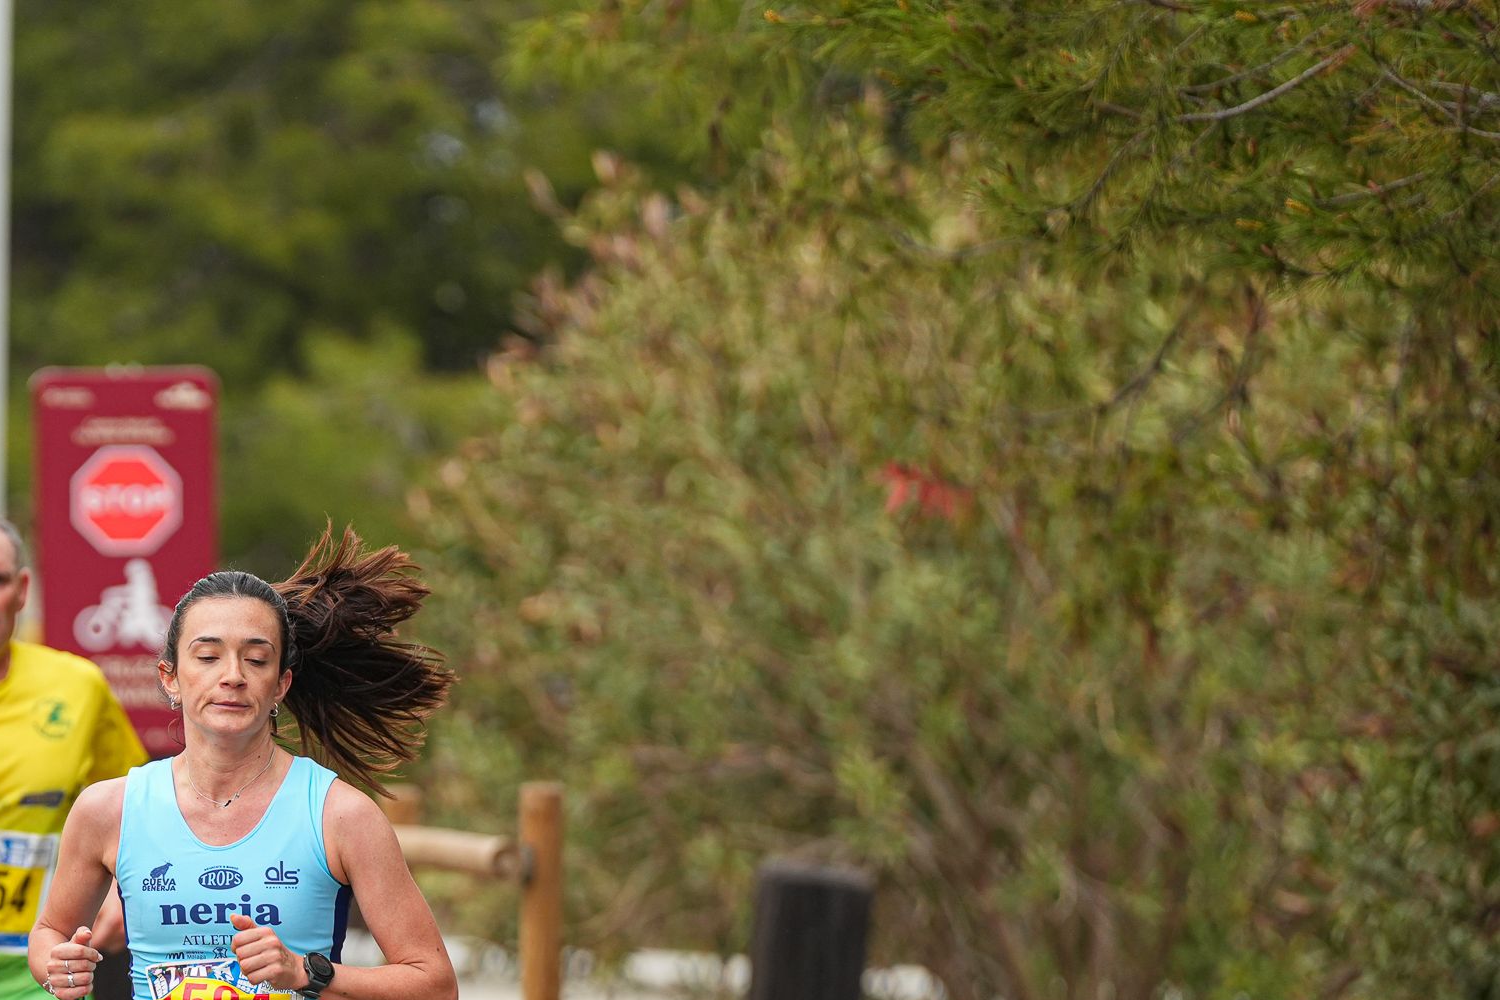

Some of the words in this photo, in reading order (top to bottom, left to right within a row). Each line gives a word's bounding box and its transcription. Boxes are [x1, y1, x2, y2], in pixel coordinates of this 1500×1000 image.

[200, 870, 241, 887] TROPS
[264, 861, 299, 885] als
[142, 878, 176, 886] CUEVA
